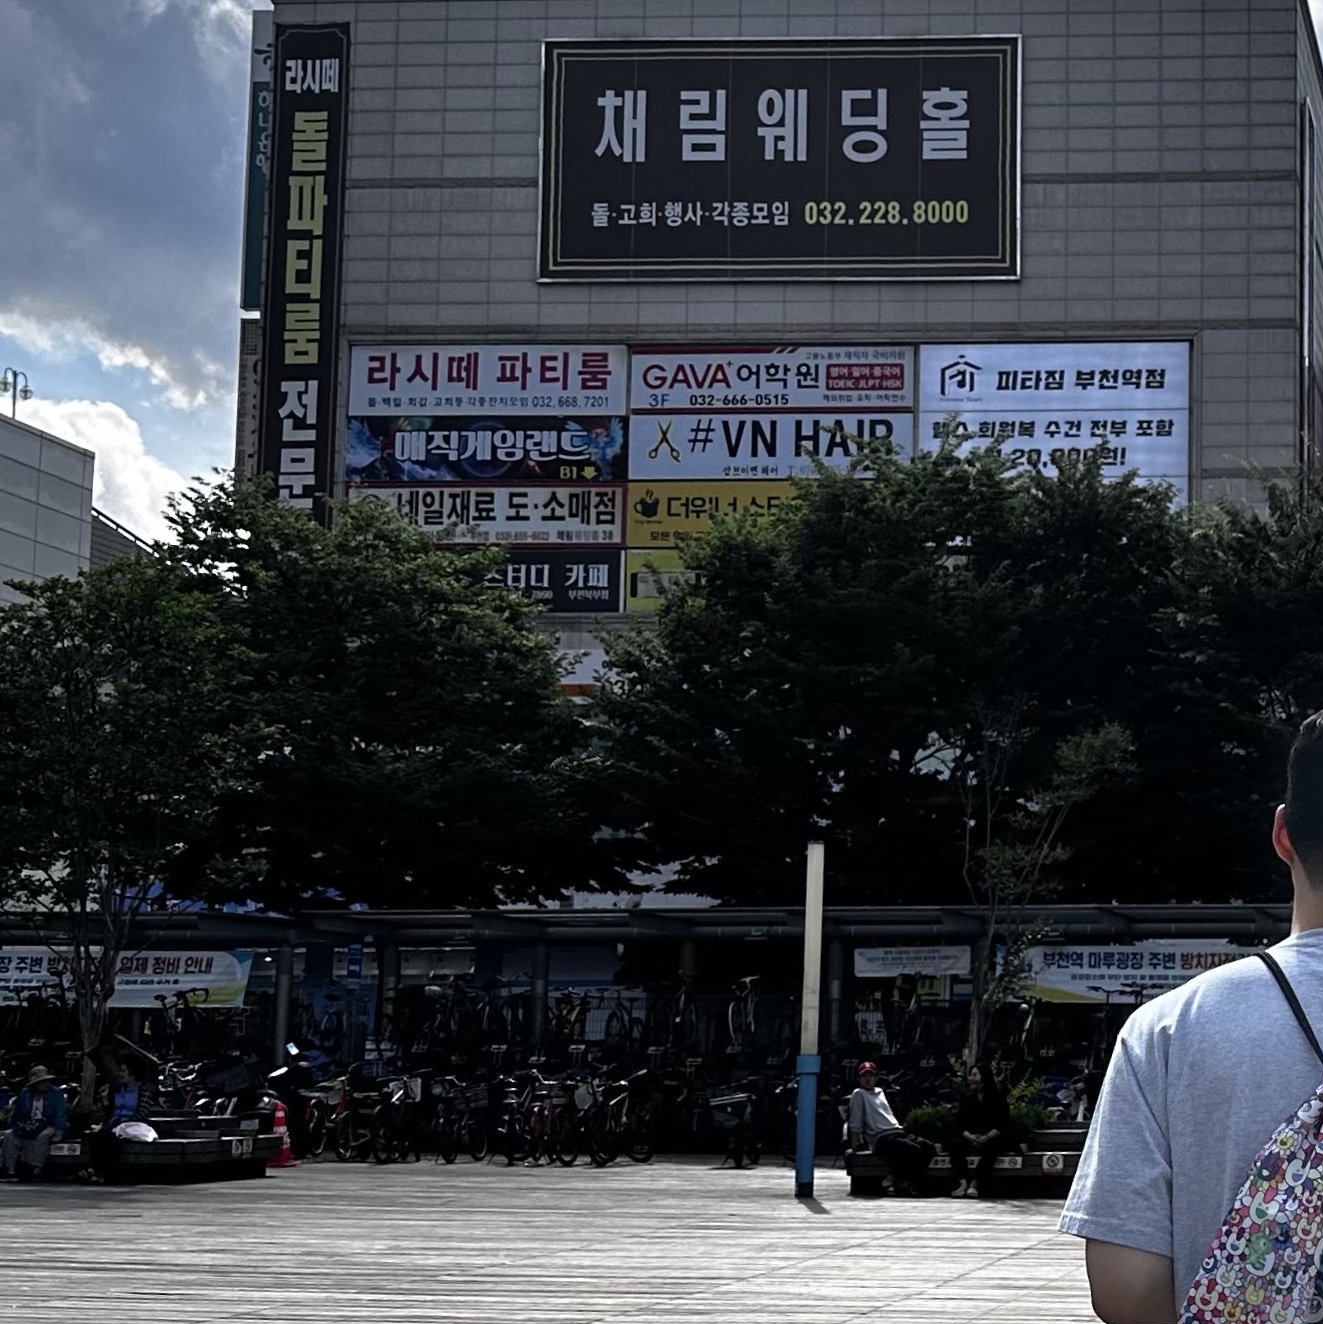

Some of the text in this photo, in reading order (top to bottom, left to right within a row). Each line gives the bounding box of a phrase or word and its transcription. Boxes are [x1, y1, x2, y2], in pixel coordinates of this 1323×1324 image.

[285, 58, 339, 94] 라시떼
[594, 87, 970, 163] 채림웨딩홀
[804, 200, 969, 225] 032.228.8000
[284, 111, 328, 364] 돌파티룸
[367, 352, 612, 391] 라시떼 파티룸
[996, 368, 1166, 391] 피타짐 부천역점
[532, 396, 609, 409] 032.668.7201
[649, 394, 789, 407] 3F 032-666-0515
[1044, 420, 1082, 438] 수건
[1089, 419, 1128, 438] 전부
[1135, 419, 1175, 438] 포함
[394, 429, 592, 462] 매직게임랜드
[560, 466, 577, 479] B1
[483, 564, 549, 589] 스터디
[564, 563, 610, 588] 카페
[15, 956, 43, 974] 주변
[152, 956, 180, 975] 정비
[184, 956, 214, 974] 안내
[1043, 951, 1084, 970] 부천역
[1088, 951, 1144, 970] 마루광장
[1148, 951, 1176, 970] 주변
